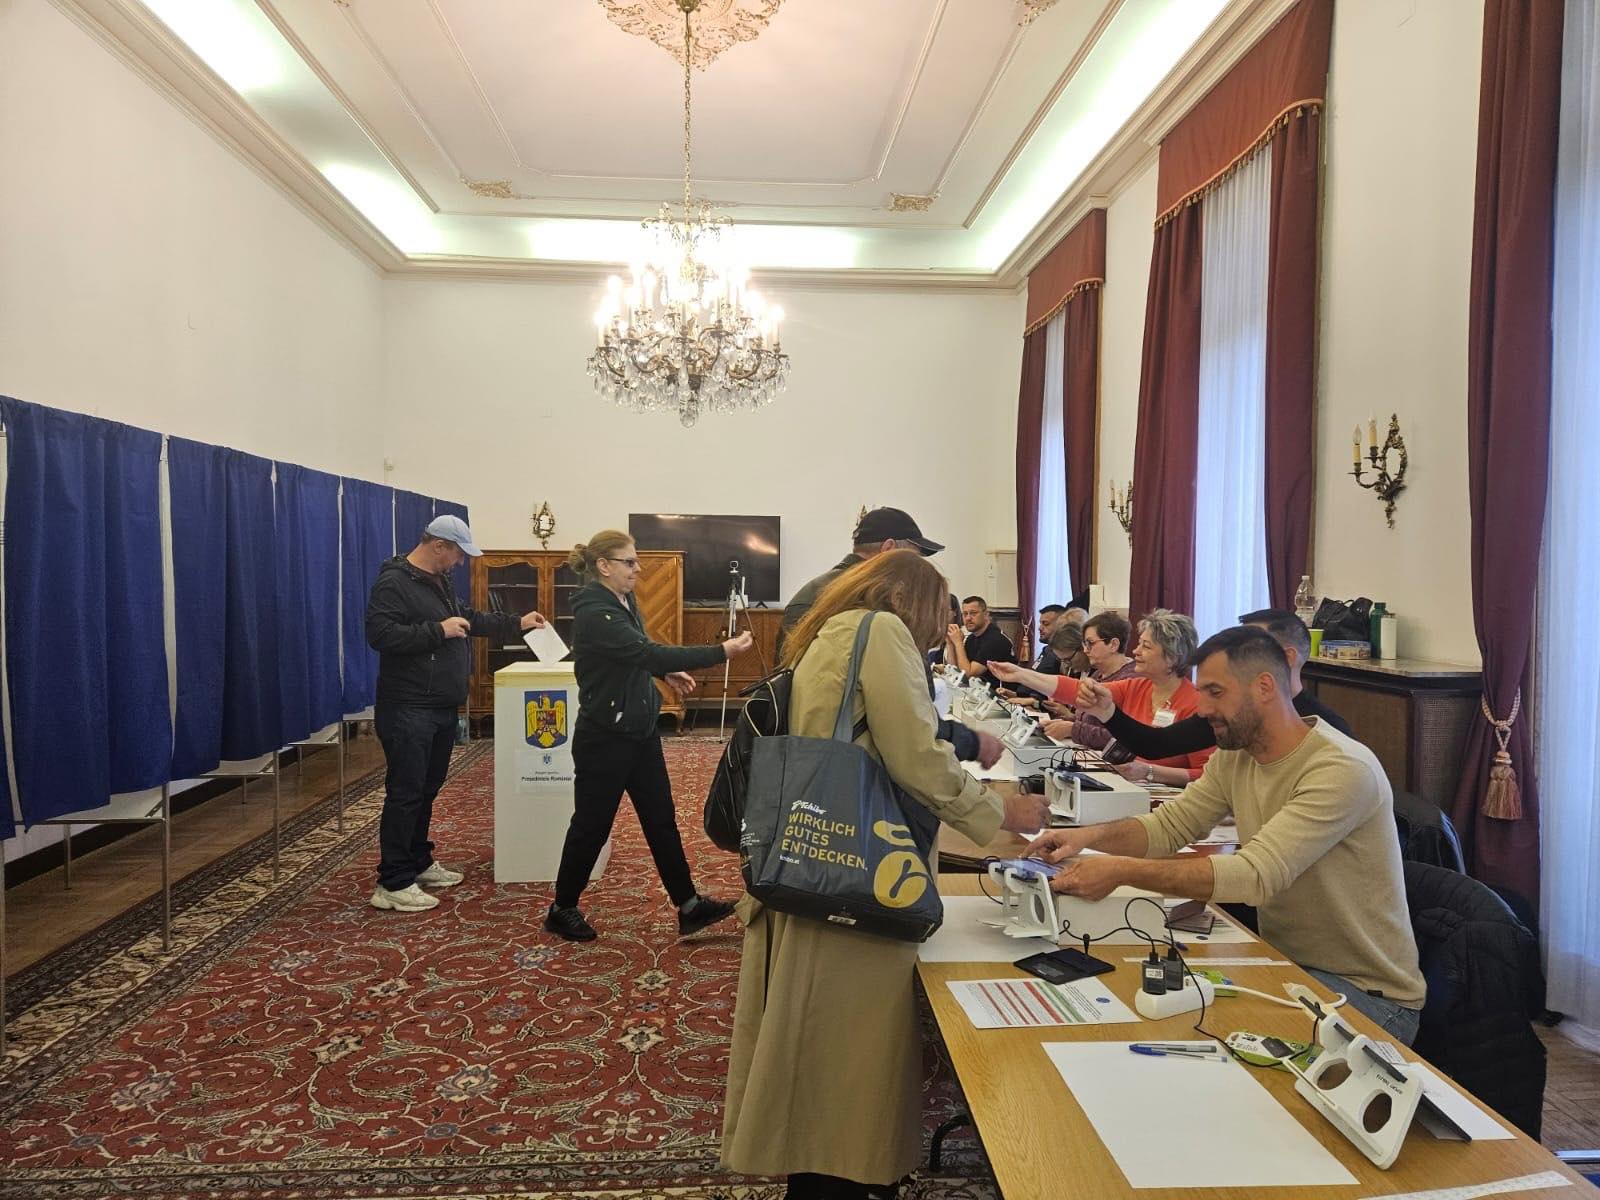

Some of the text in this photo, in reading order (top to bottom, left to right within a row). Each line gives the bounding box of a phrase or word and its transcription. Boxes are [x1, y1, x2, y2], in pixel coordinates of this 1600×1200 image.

[785, 825, 830, 846] GUTES
[788, 812, 855, 837] WIRKLICH
[781, 838, 869, 871] ENTDECKEN.
